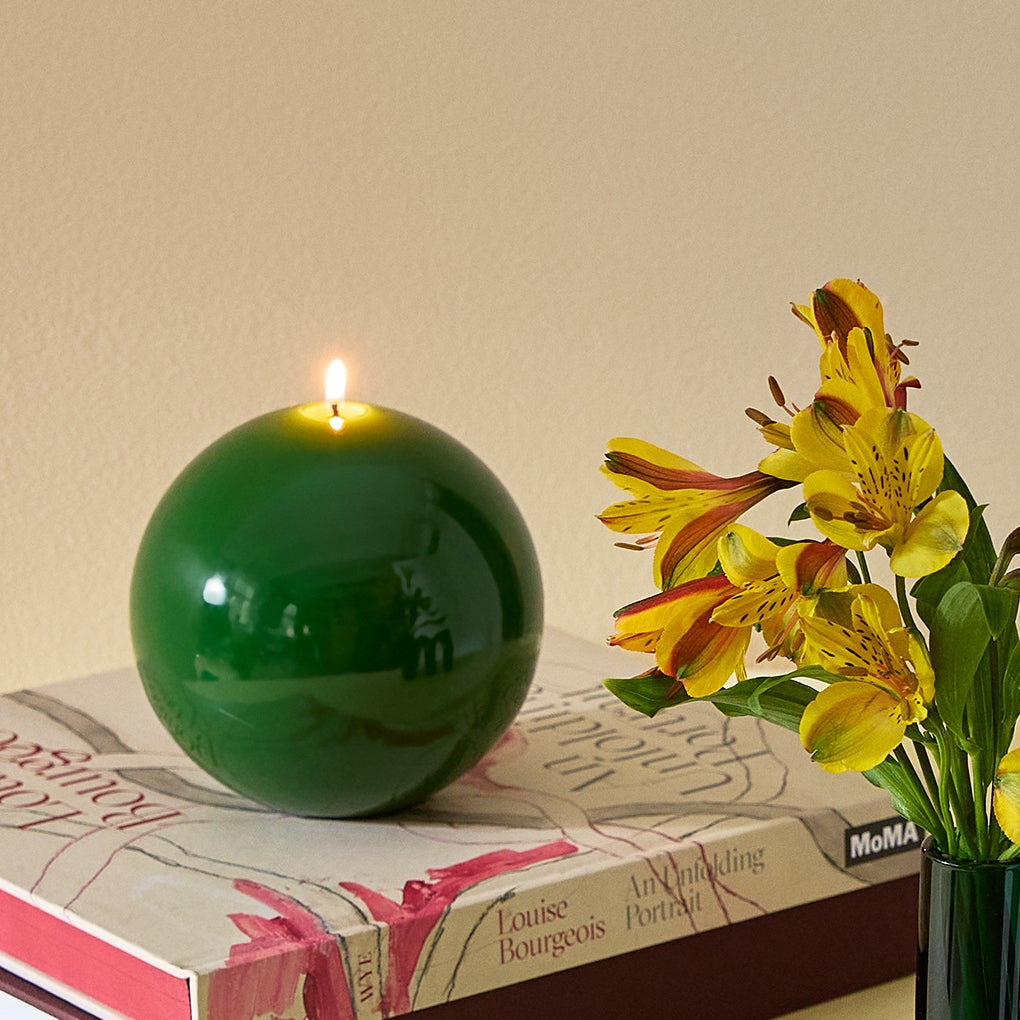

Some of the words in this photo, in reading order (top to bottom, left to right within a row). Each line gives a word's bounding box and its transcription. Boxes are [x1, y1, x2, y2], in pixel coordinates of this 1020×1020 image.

[514, 684, 732, 795] Unfoldin
[560, 684, 772, 767] Portrit
[0, 730, 183, 830] Bourge
[850, 821, 919, 858] MoMA
[626, 875, 656, 902] An
[660, 847, 765, 889] Unfolding
[498, 899, 568, 935] Louise
[626, 888, 702, 930] Portrait
[500, 915, 606, 964] Bourgeois
[357, 951, 374, 1003] WYE
